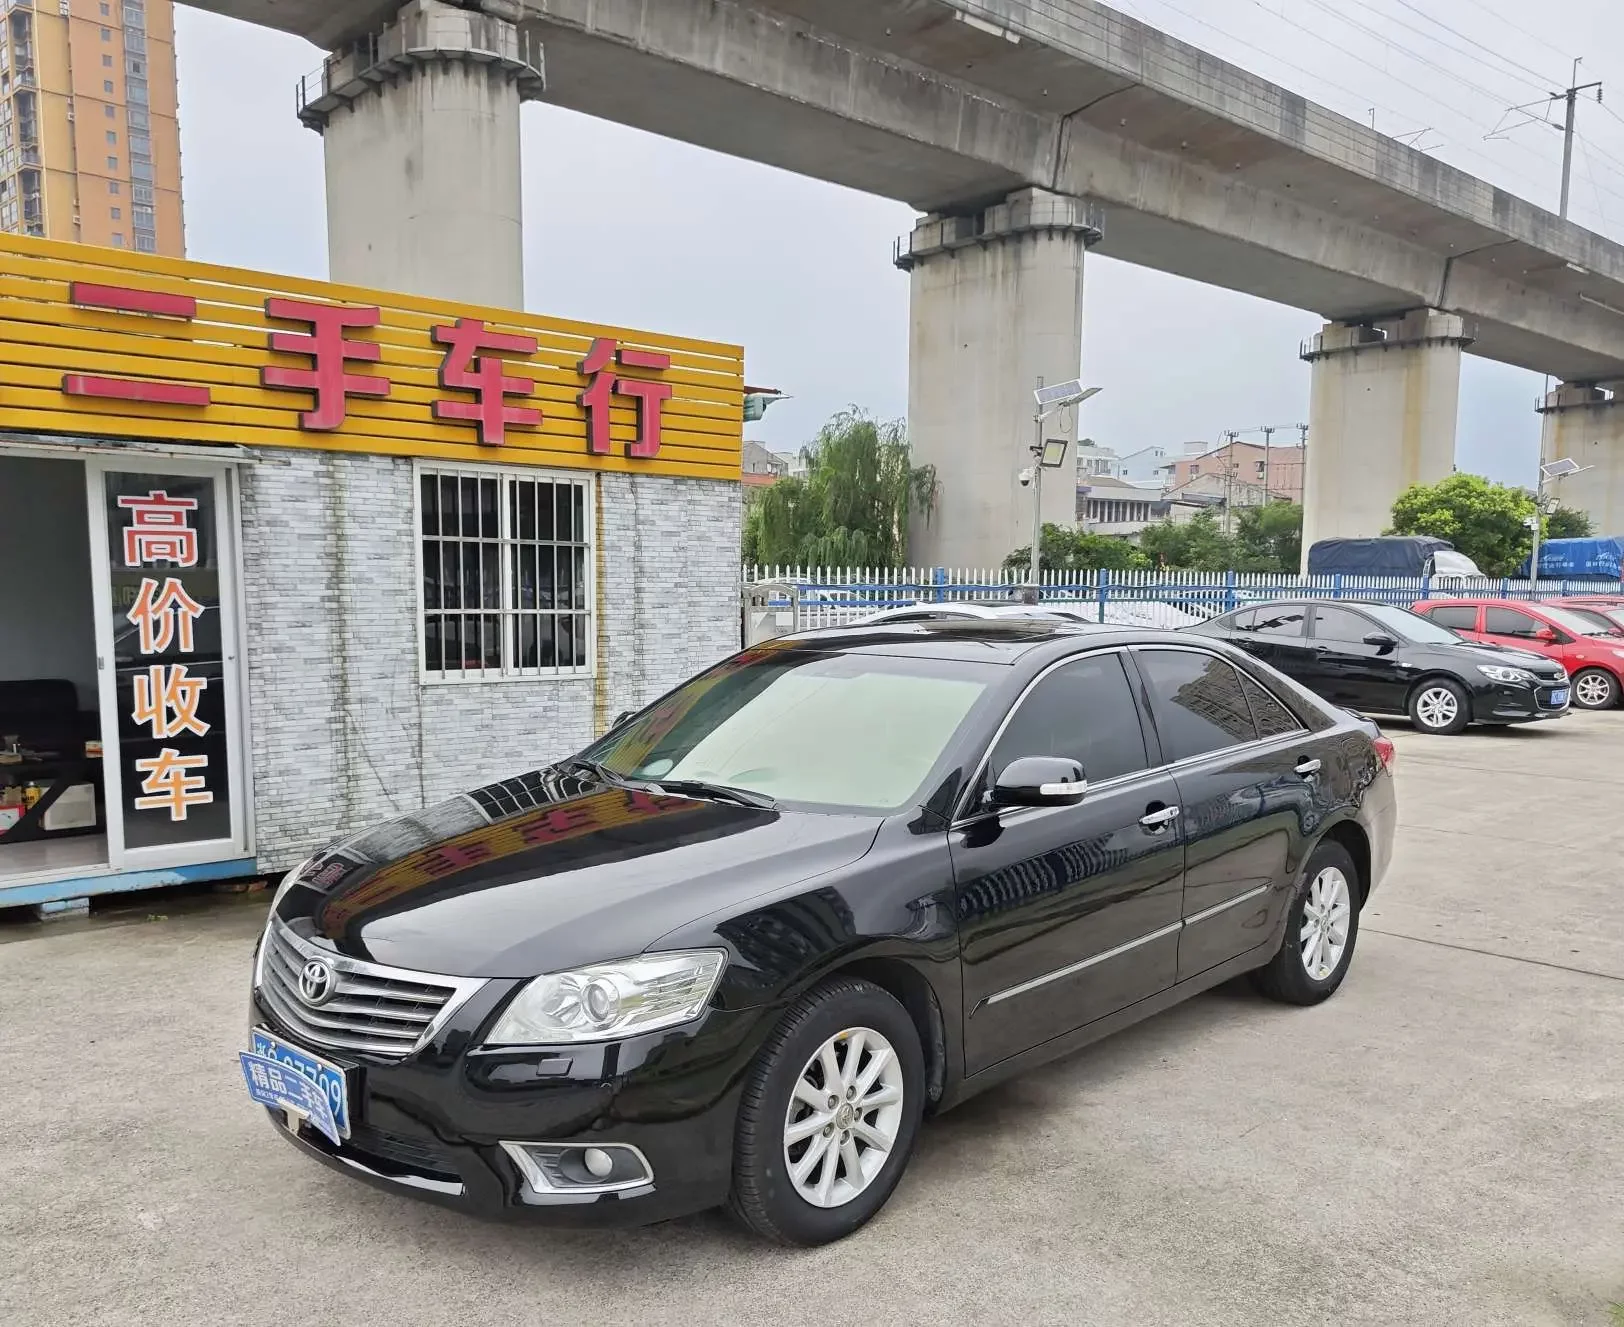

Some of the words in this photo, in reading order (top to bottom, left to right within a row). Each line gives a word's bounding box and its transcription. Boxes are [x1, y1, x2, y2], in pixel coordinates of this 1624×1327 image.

[62, 281, 673, 459] 二手车行
[117, 490, 213, 821] 高价收车
